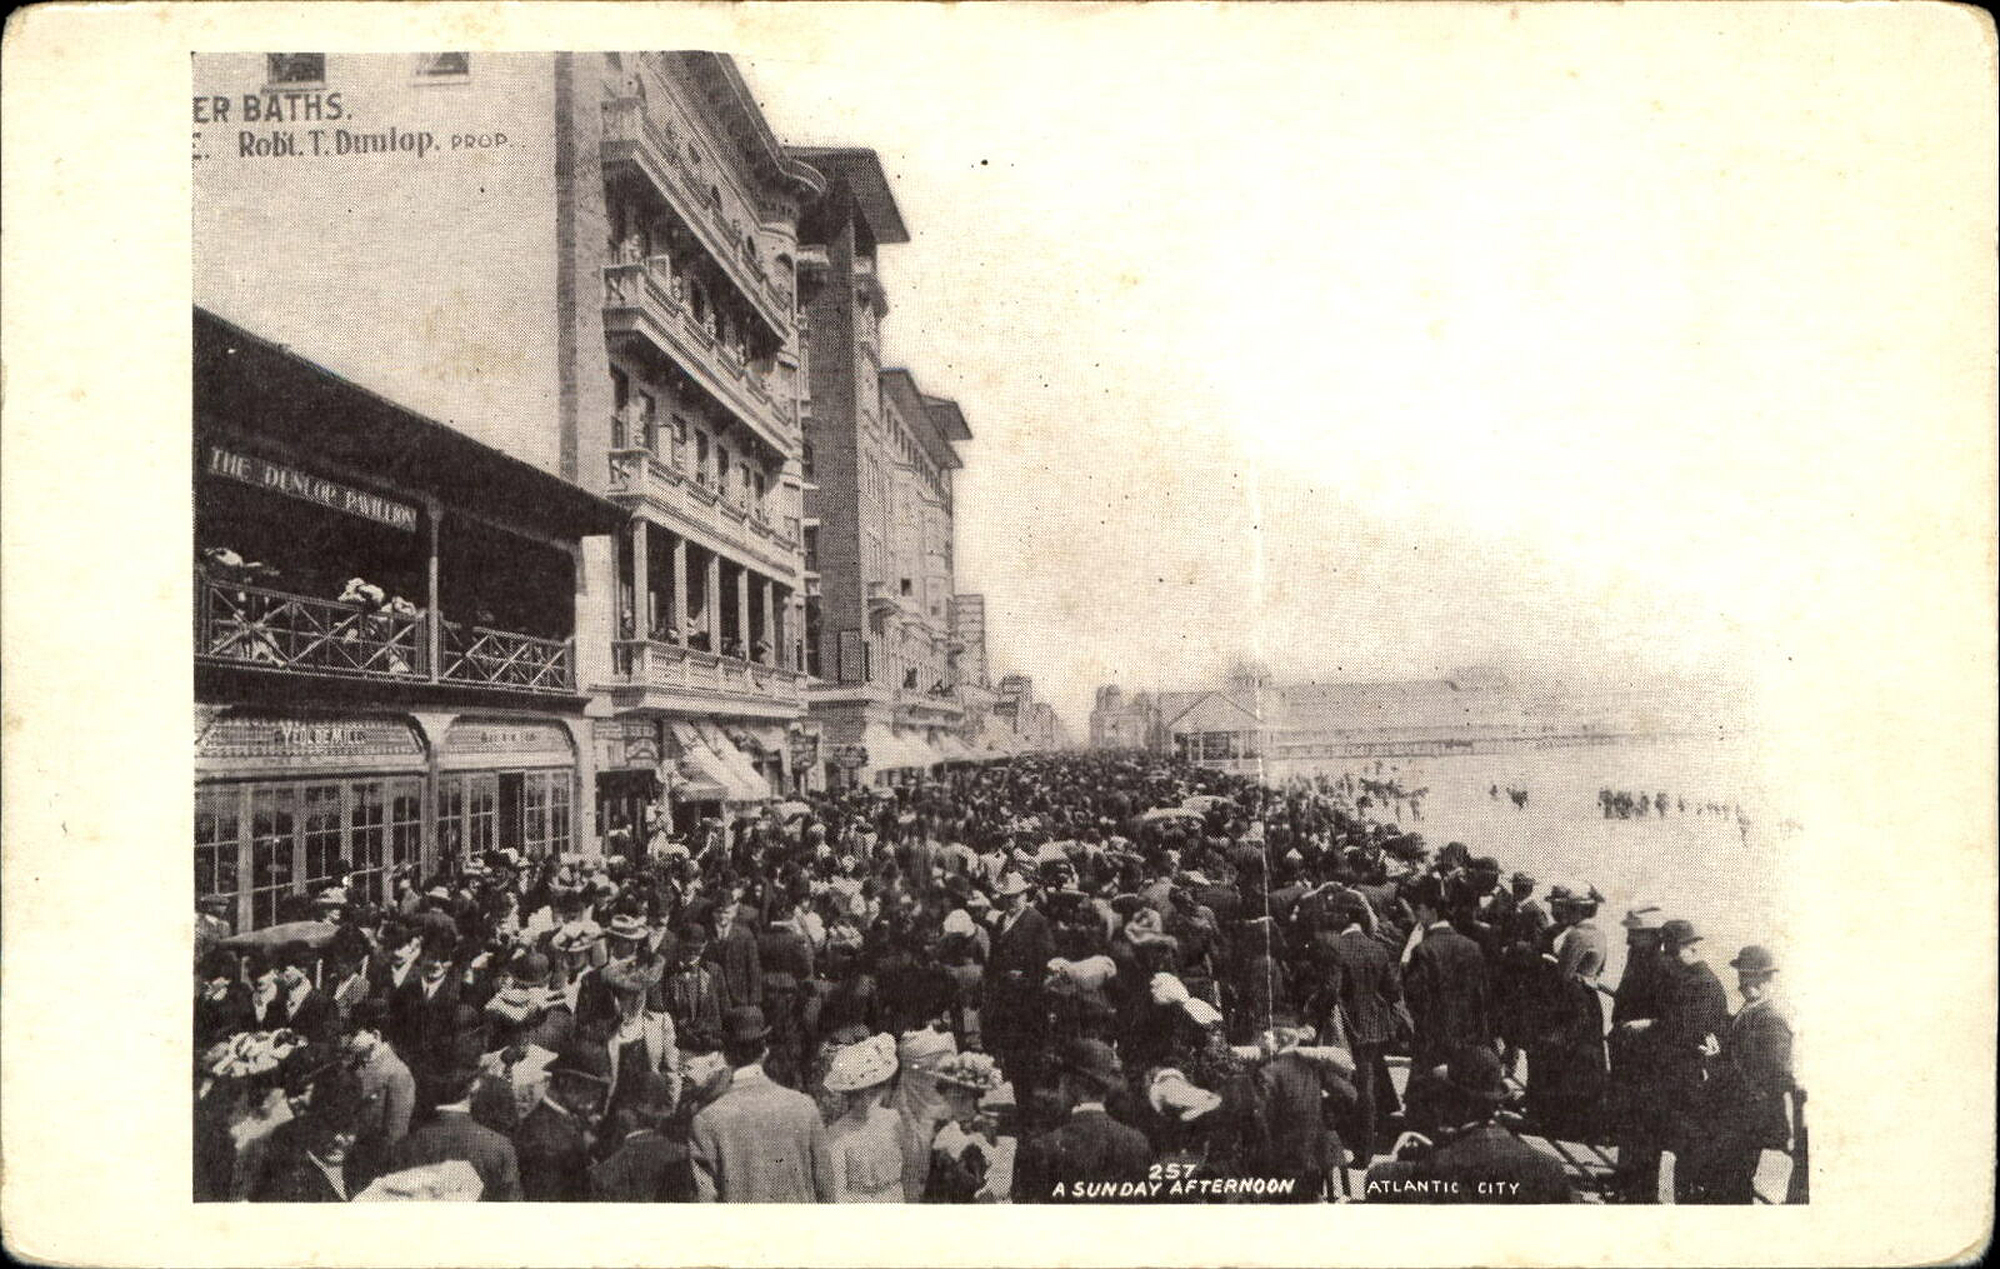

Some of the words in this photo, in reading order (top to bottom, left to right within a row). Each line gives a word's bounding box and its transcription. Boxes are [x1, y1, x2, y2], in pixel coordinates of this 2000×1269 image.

[192, 96, 230, 123] ER
[242, 92, 352, 122] BATHS.
[210, 447, 251, 479] THE
